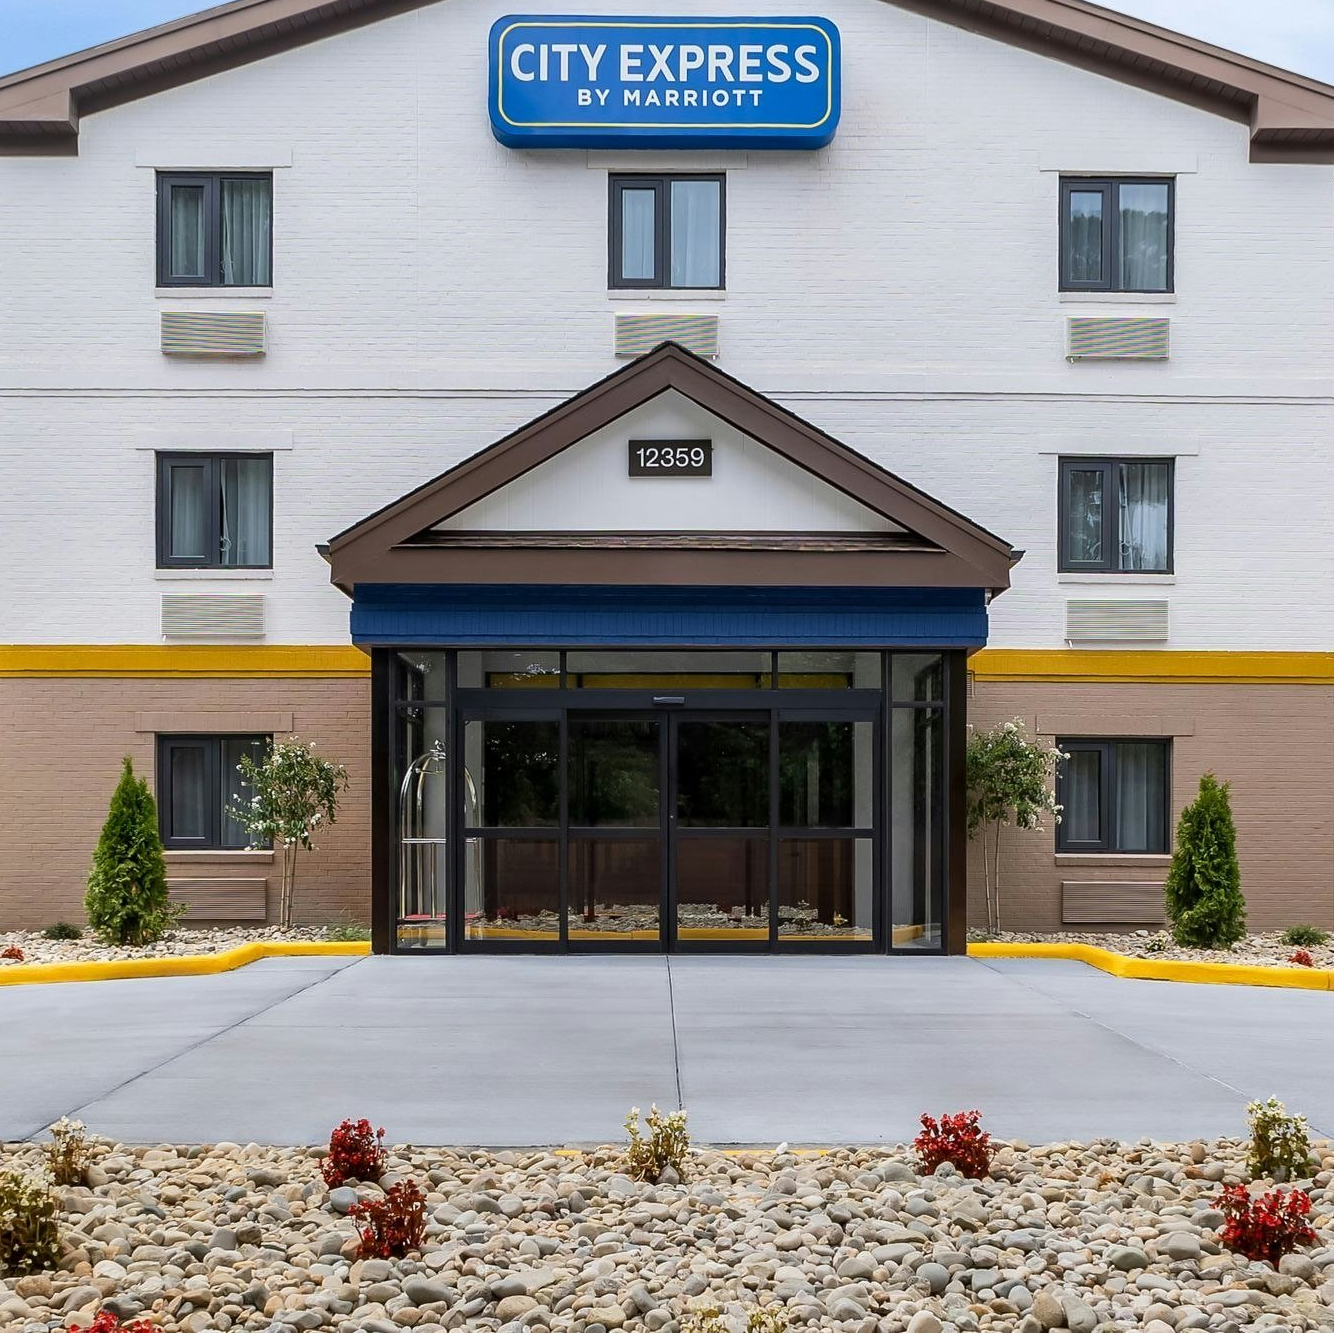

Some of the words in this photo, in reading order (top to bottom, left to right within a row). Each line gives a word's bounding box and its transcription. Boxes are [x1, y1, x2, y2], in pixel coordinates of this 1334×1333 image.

[510, 43, 607, 82] CITY
[620, 44, 820, 83] EXPRESS
[578, 89, 610, 106] BY
[623, 89, 763, 107] MARRIOTT
[636, 447, 705, 468] 12359
